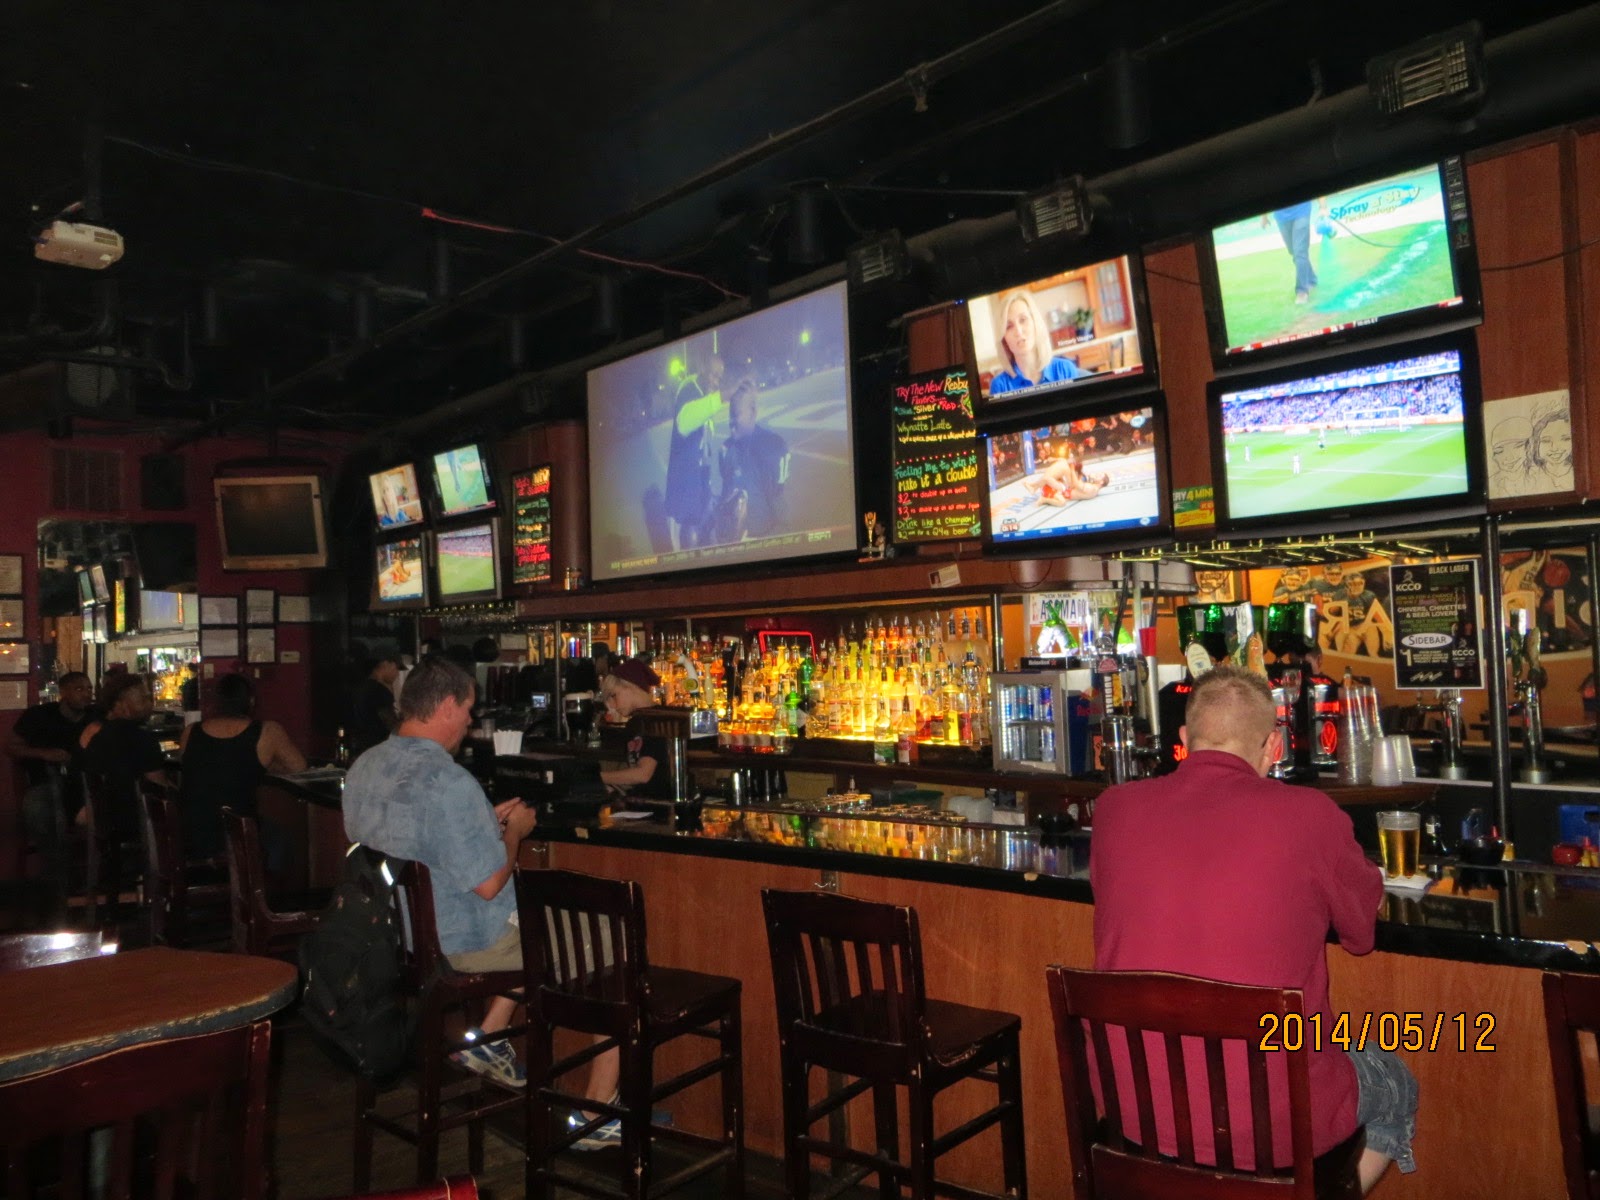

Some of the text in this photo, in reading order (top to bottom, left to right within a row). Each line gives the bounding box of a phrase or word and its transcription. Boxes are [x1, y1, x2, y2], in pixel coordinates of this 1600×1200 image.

[1329, 202, 1369, 220] Spray
[1396, 582, 1421, 592] KCCO
[1408, 635, 1447, 646] SIDEBAR
[1104, 676, 1114, 714] AUDIBLE
